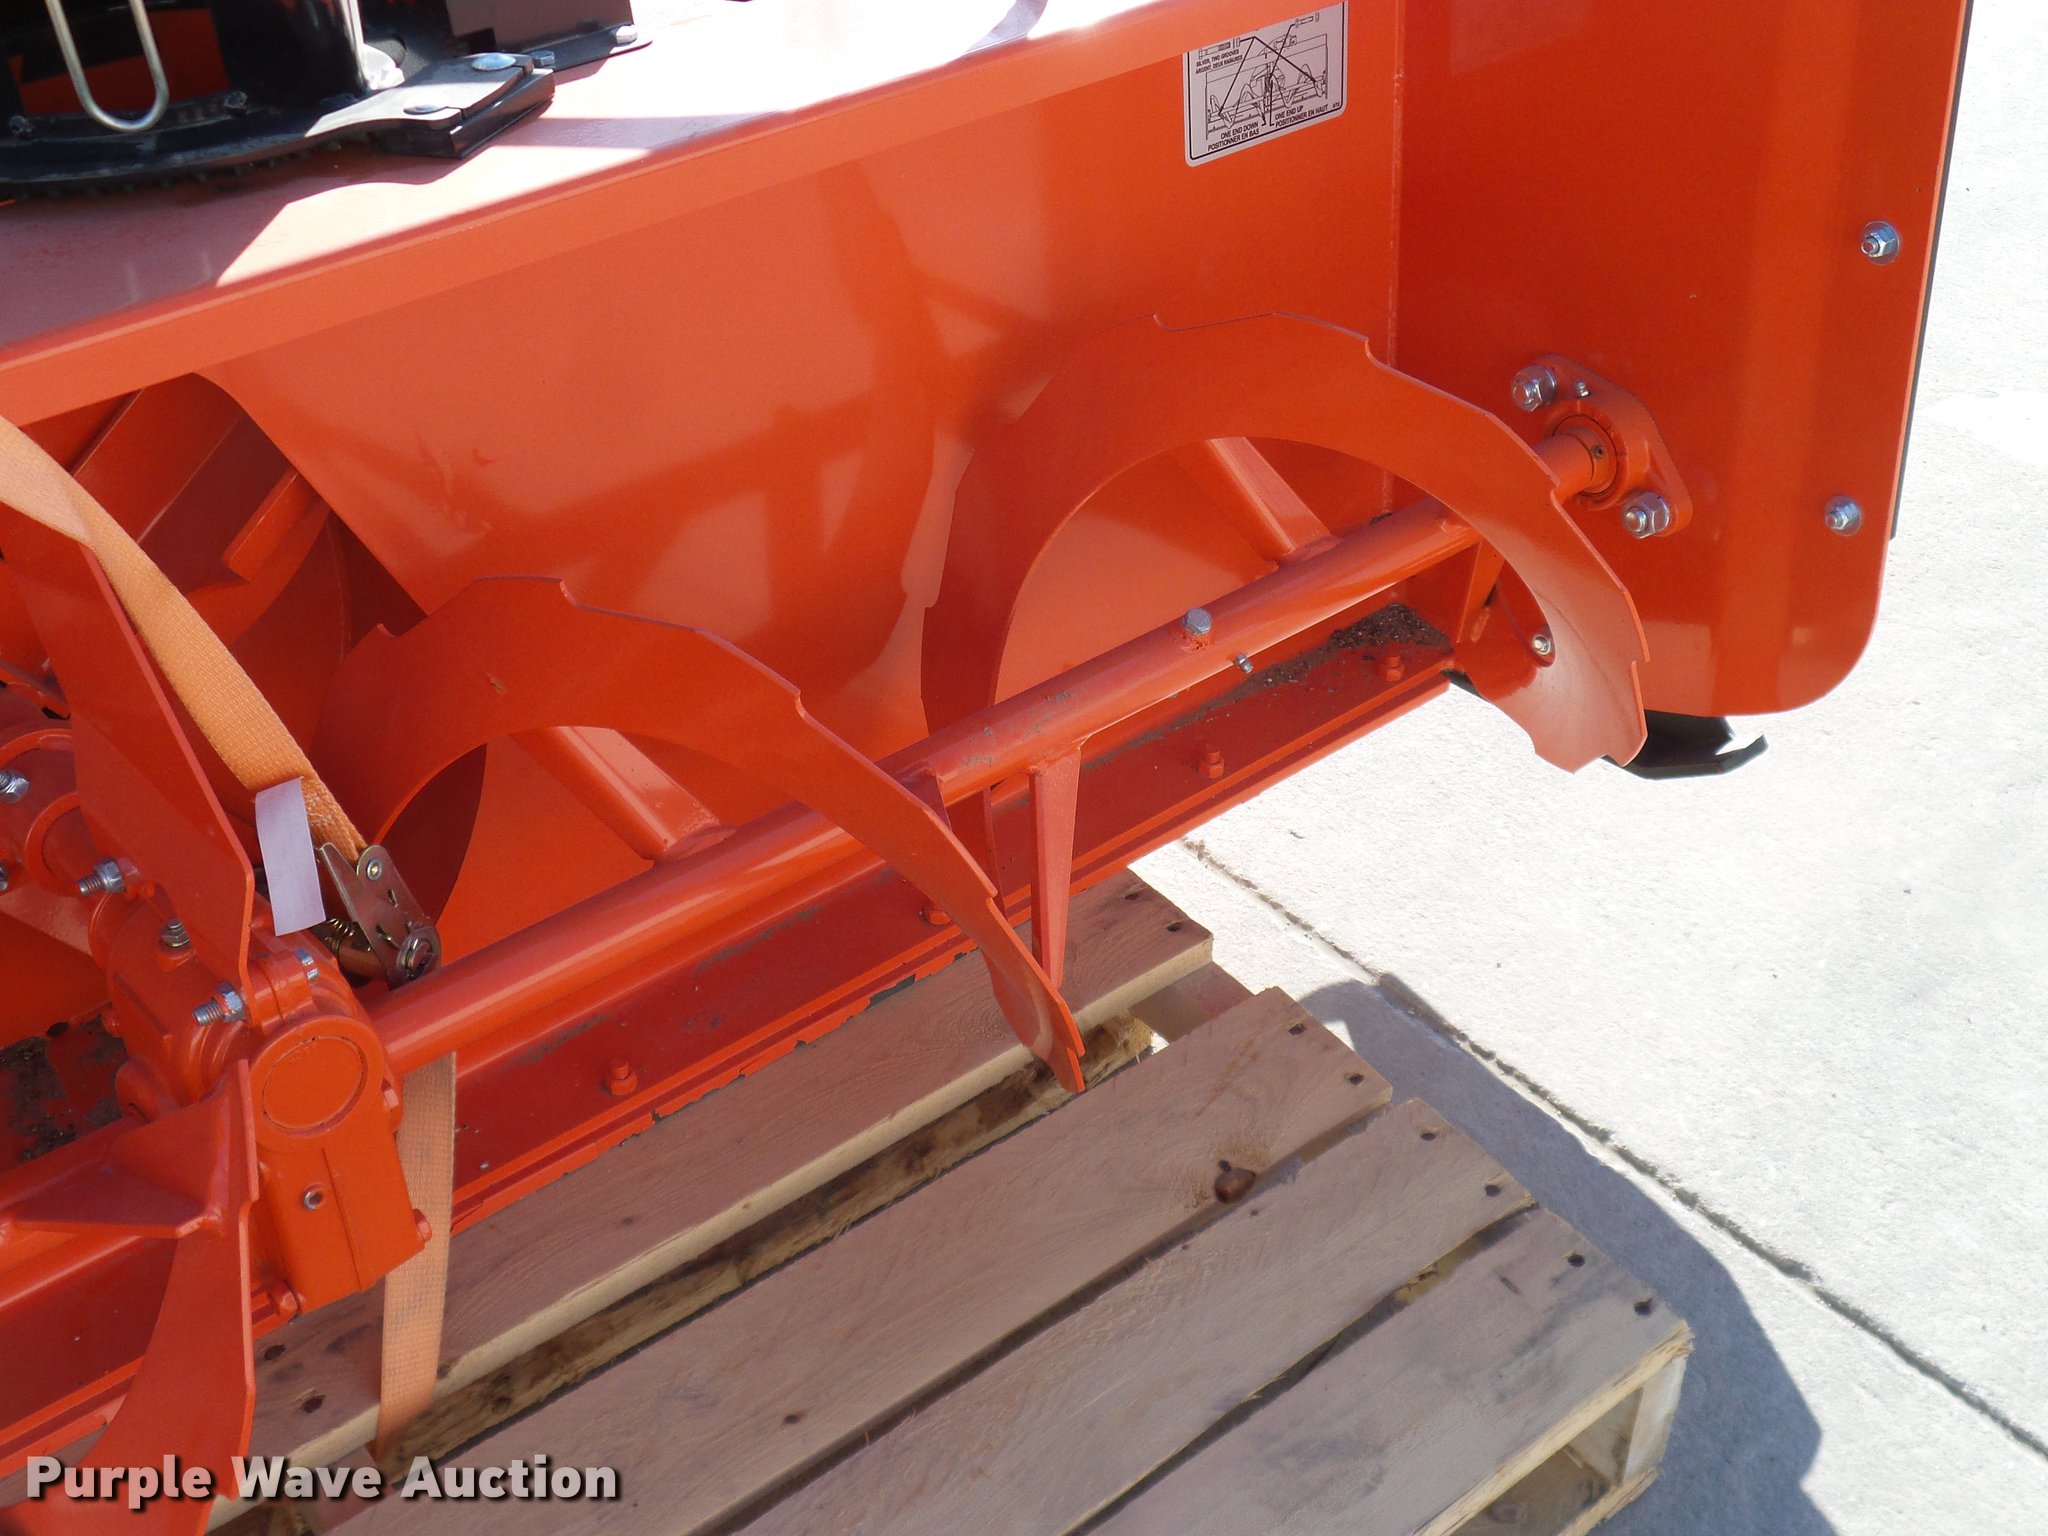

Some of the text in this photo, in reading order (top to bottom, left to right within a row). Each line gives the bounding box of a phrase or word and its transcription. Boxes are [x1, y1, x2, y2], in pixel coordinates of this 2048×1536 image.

[1221, 49, 1239, 59] GROOVES
[1213, 61, 1223, 69] DEUX
[1275, 111, 1285, 120] ONE
[1286, 108, 1296, 117] END
[1275, 112, 1307, 128] POSITIONNER
[1315, 104, 1328, 113] HAUT
[1220, 121, 1259, 139] ONE END DOWN
[1208, 135, 1241, 151] POSITIONNER
[1249, 128, 1259, 137] BAS
